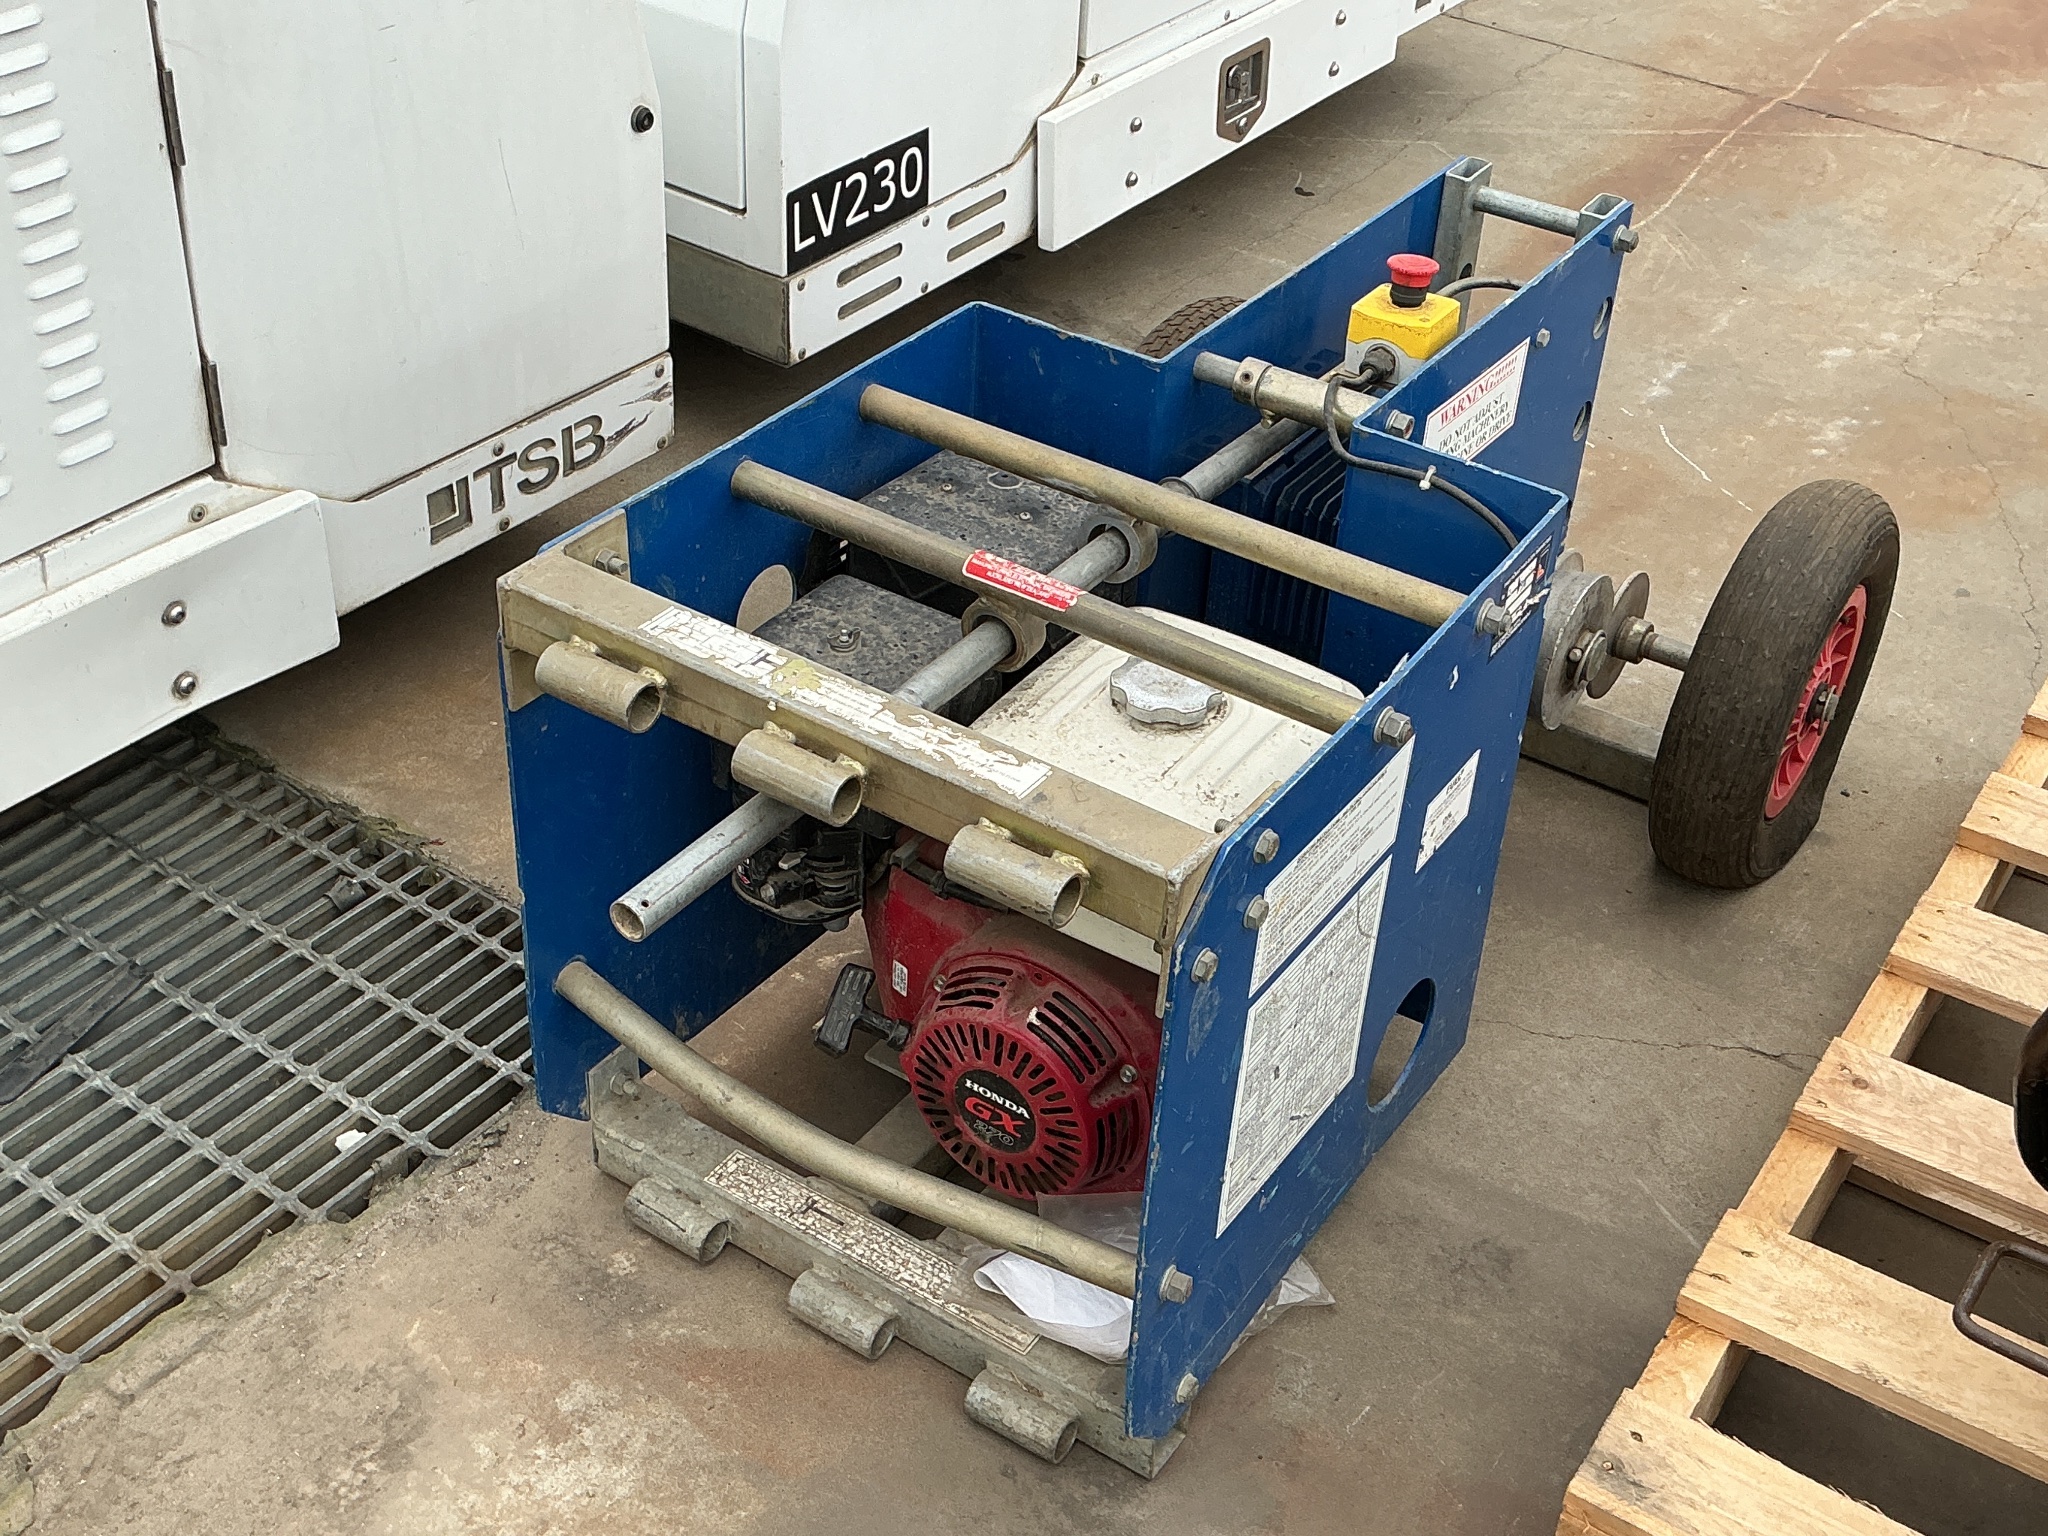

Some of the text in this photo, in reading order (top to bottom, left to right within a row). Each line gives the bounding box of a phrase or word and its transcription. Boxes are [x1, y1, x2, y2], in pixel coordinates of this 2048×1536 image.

[793, 146, 923, 253] LV230
[1439, 391, 1505, 452] DO NOT ADJUST
[1463, 401, 1509, 445] MACHINERY
[1475, 431, 1488, 448] OR
[964, 1078, 1031, 1120] HONDA
[964, 1096, 1026, 1139] GX
[974, 1119, 1015, 1146] 270
